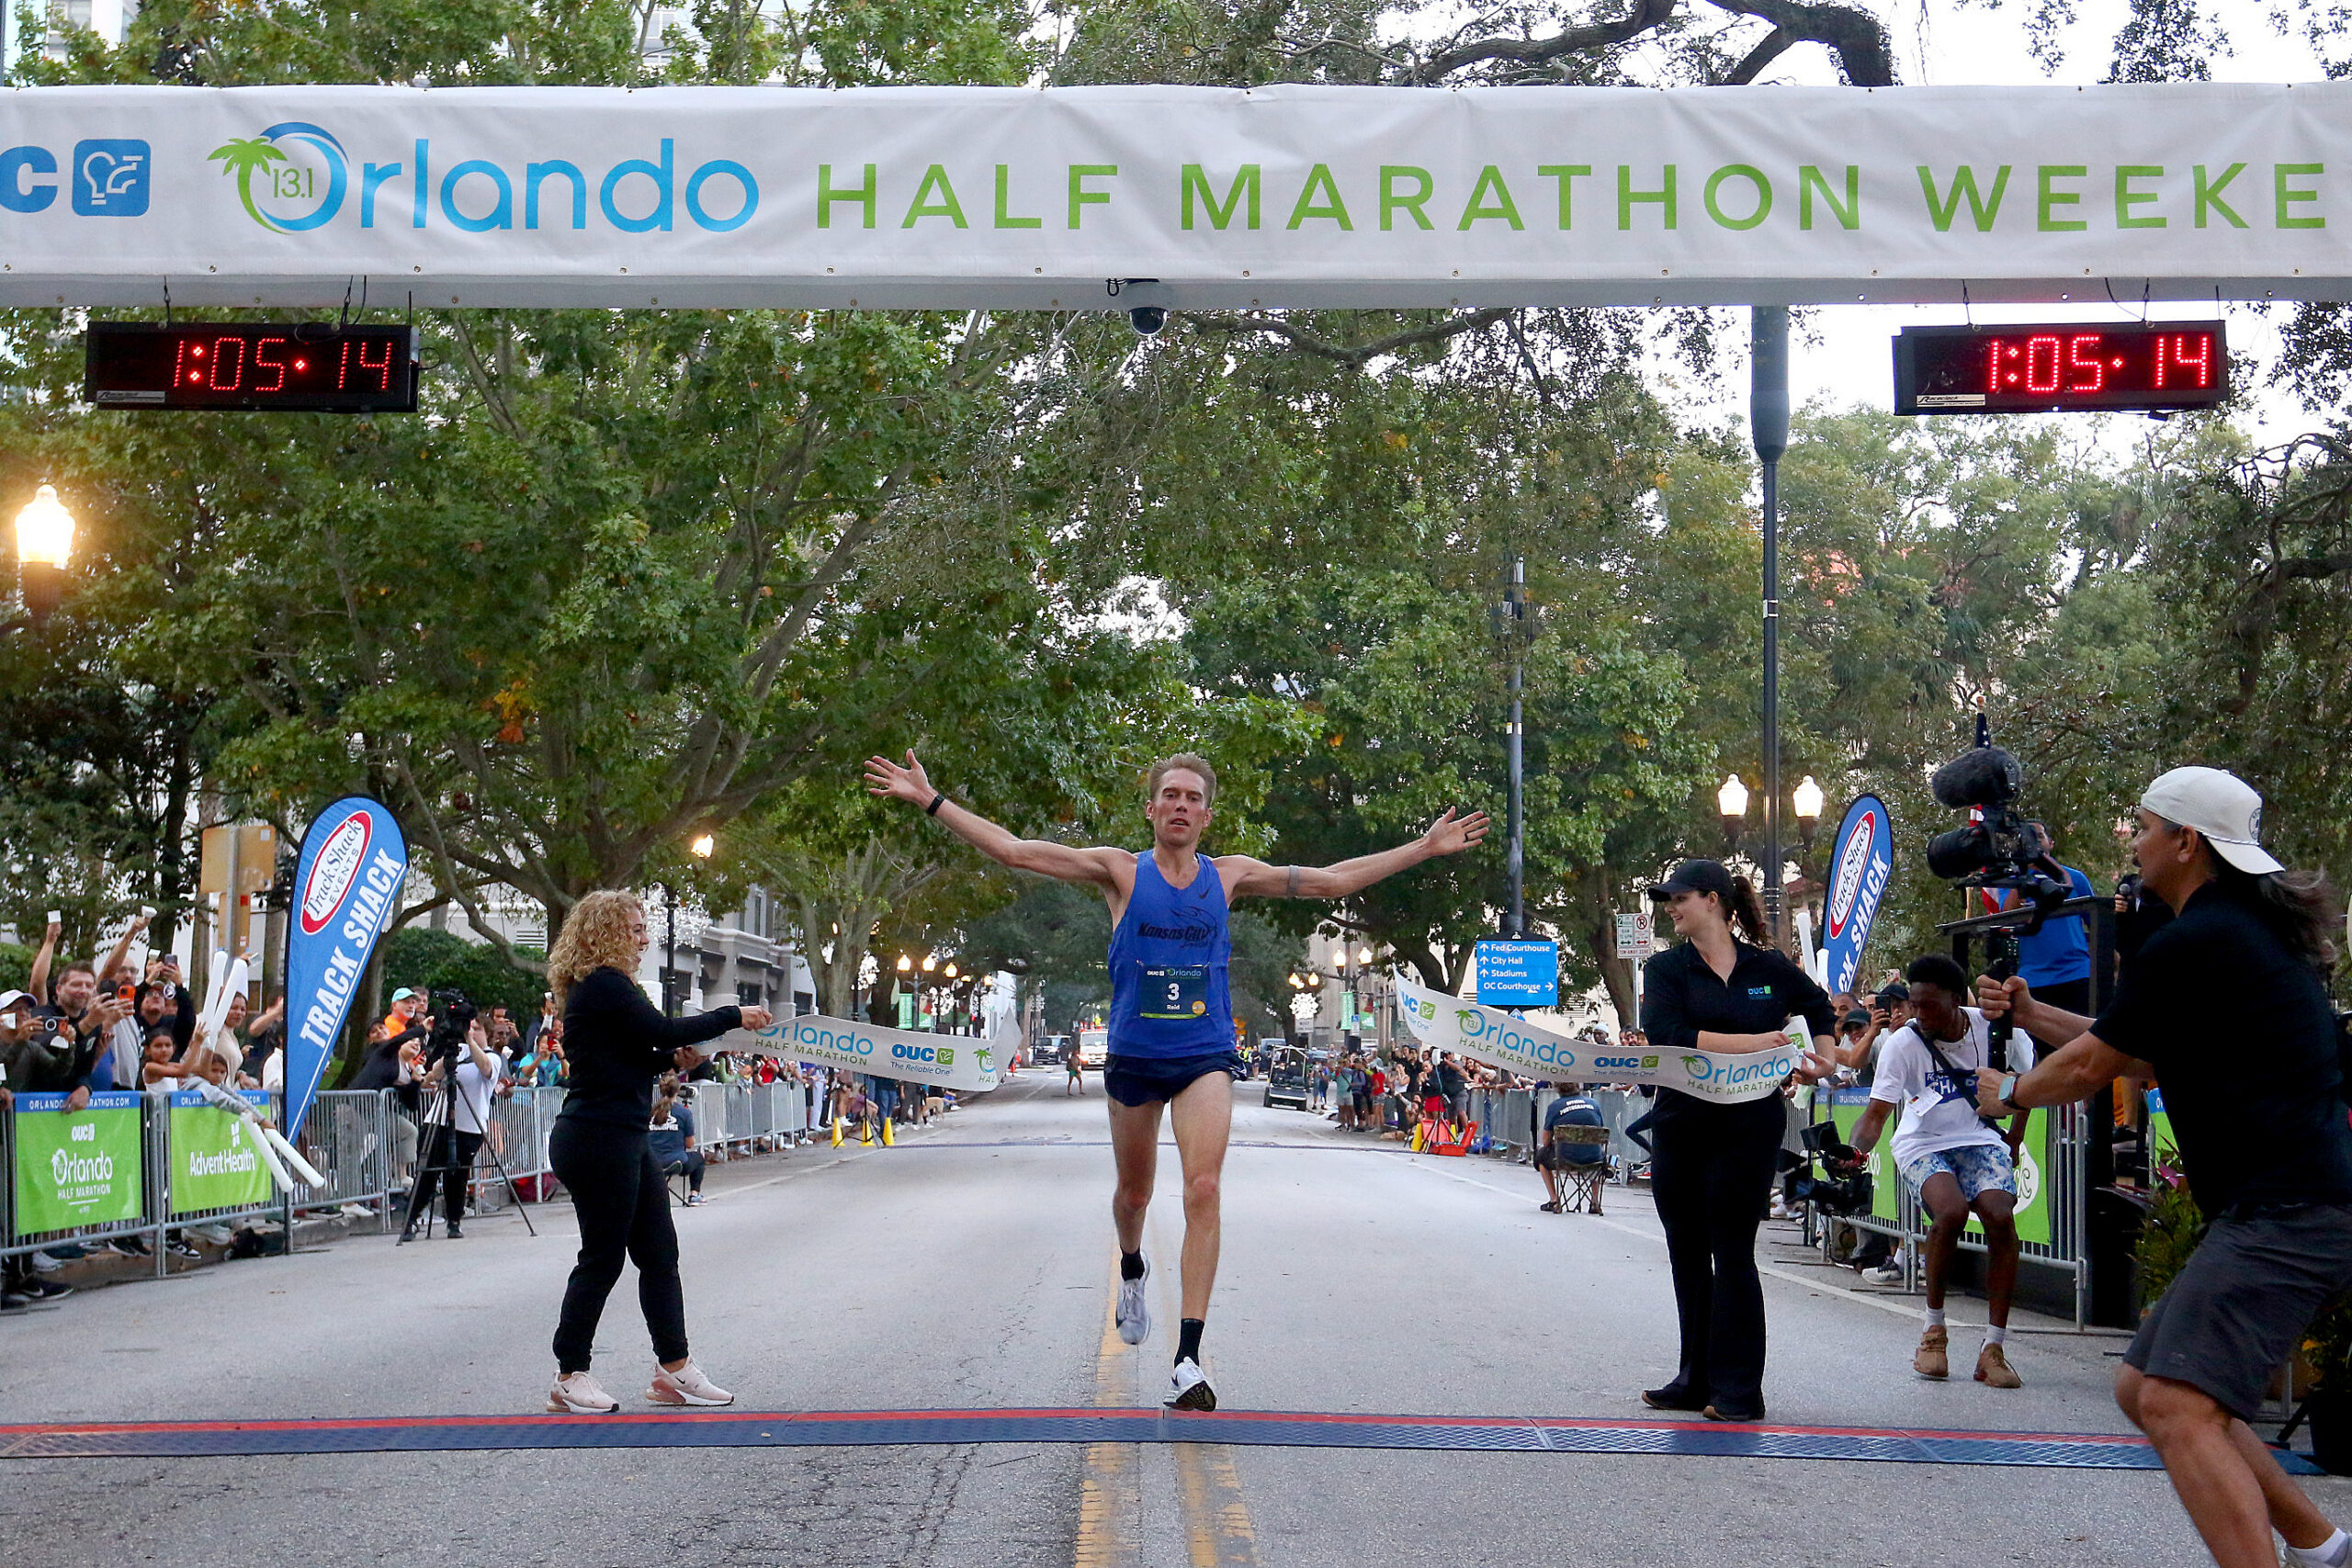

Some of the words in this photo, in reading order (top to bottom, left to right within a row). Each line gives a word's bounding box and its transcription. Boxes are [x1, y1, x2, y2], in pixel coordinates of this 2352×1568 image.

[241, 121, 759, 233] Orlando
[817, 164, 1119, 230] HALF
[1181, 163, 1861, 231] MARATHON
[1917, 162, 2327, 232] WEEKE
[274, 168, 312, 197] 13.1
[306, 869, 335, 918] Track
[326, 821, 362, 872] Shack
[330, 848, 359, 903] EVENTS
[1850, 850, 1888, 952] SHACK
[300, 945, 359, 1050] TRACK
[344, 847, 402, 950] SHACK
[1491, 943, 1506, 952] Fed
[1507, 943, 1550, 952] Courthouse
[1491, 956, 1507, 965] City
[1508, 956, 1523, 964] Hall
[1167, 968, 1202, 976] Orlando
[1491, 969, 1527, 977] Stadiums
[1167, 982, 1180, 1001] 3
[1484, 982, 1496, 990] OC
[1497, 982, 1541, 990] Courthouse
[1747, 987, 1764, 995] OUC
[1399, 990, 1418, 1012] UC
[1459, 1009, 1576, 1067] Orlando
[755, 1038, 789, 1051] HALF
[795, 1044, 867, 1066] MARATHON
[891, 1043, 934, 1062] OUC
[1459, 1036, 1493, 1054] HALF
[1496, 1048, 1569, 1076] MARATHON
[1594, 1056, 1639, 1067] OUC
[890, 1061, 904, 1070] The
[906, 1063, 933, 1074] Reliable
[934, 1066, 951, 1077] One
[1685, 1055, 1790, 1085] Orlando
[978, 1075, 995, 1083] HAL
[1687, 1078, 1723, 1095] HALF
[1726, 1079, 1781, 1096] MARATHO
[72, 1125, 88, 1142] OUC
[53, 1148, 113, 1186] Orlando
[58, 1188, 74, 1200] HALF
[76, 1184, 110, 1198] MARATHON
